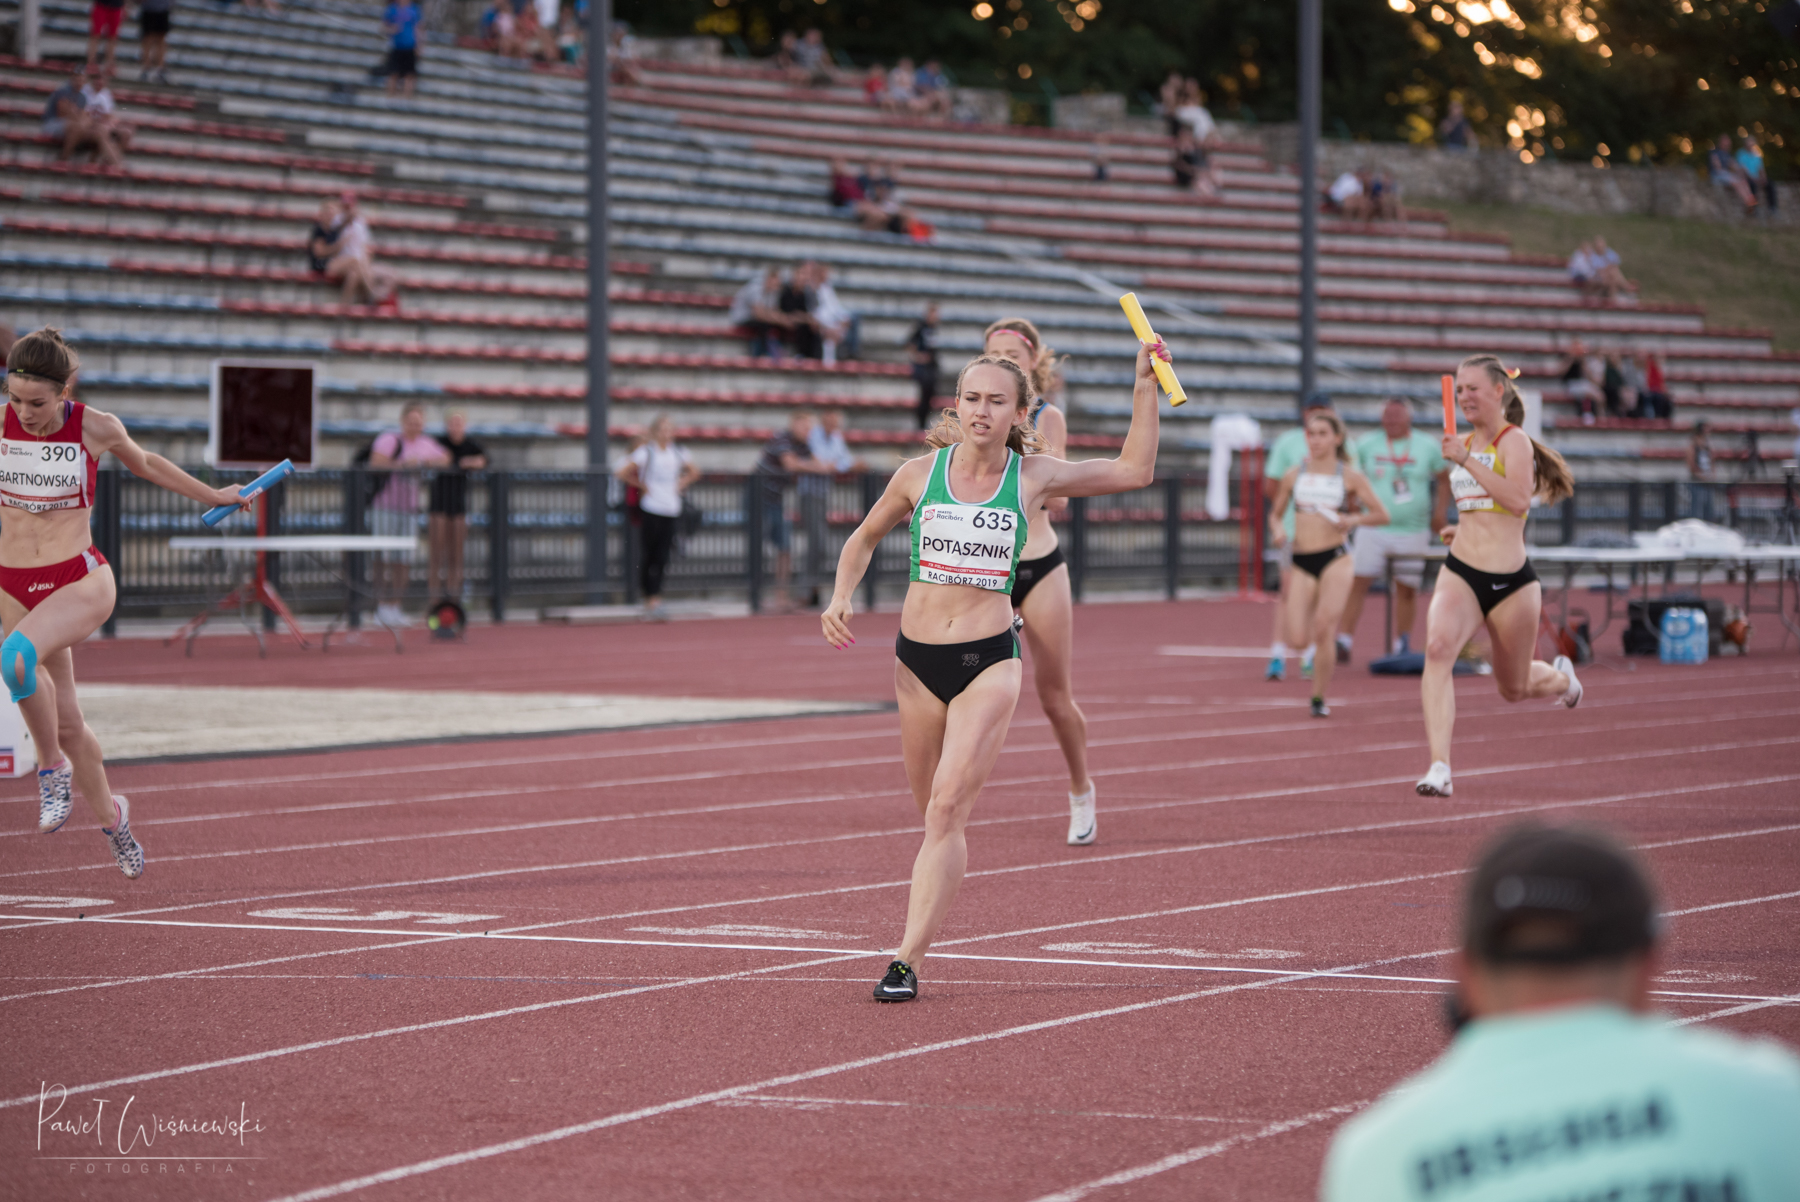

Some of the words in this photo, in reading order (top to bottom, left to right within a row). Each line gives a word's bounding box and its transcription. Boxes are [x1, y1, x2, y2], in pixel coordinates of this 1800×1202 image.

[41, 445, 77, 462] 390
[0, 470, 77, 487] BARTNOWSKA
[9, 498, 47, 511] RACIBÓRZ
[49, 500, 69, 509] 2019
[936, 513, 964, 521] Racibórz
[972, 510, 1012, 531] 635
[922, 536, 1011, 559] POTASZNIK
[927, 571, 972, 585] RACIBÓRZ
[976, 577, 998, 587] 2019
